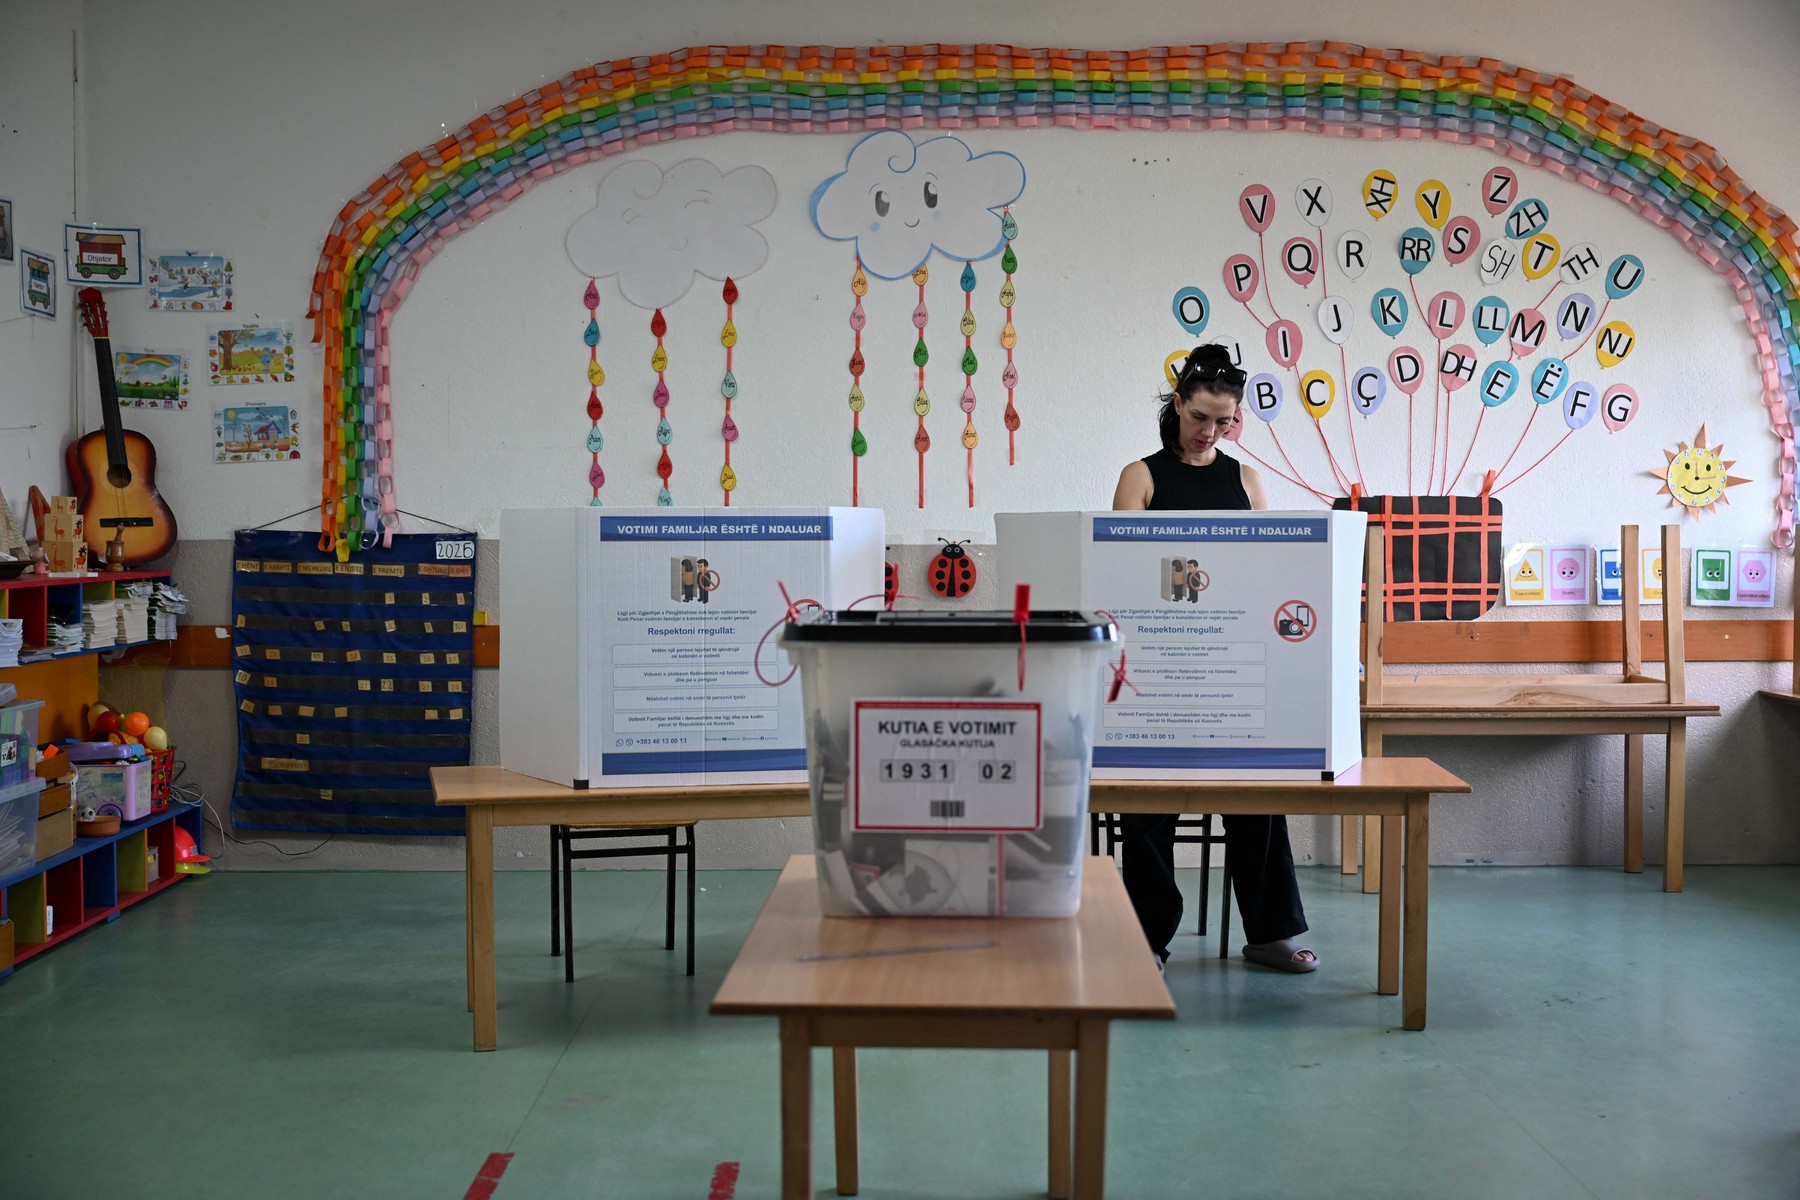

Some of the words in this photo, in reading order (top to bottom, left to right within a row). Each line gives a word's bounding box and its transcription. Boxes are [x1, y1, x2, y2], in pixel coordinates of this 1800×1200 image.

[1303, 186, 1325, 216] X
[1366, 176, 1395, 213] XH
[1490, 175, 1510, 203] Z
[1246, 195, 1267, 223] V
[1422, 191, 1440, 219] Y
[1509, 202, 1547, 237] ZH
[1346, 241, 1364, 267] R
[1401, 238, 1431, 261] RR
[1448, 228, 1468, 254] S
[1536, 241, 1554, 269] T
[1288, 244, 1315, 274] Q
[1481, 246, 1515, 279] SH
[1562, 248, 1599, 280] TH
[1234, 264, 1251, 292] P
[1614, 261, 1641, 289] U
[1180, 297, 1203, 324] O
[1332, 305, 1342, 332] J
[1380, 296, 1400, 325] K
[1439, 300, 1453, 328] L
[1478, 306, 1504, 331] LL
[1562, 301, 1589, 332] N
[1511, 313, 1545, 346] M
[1599, 328, 1632, 358] NJ
[1282, 331, 1288, 357] I
[1396, 355, 1419, 382] D
[1441, 350, 1477, 381] DH
[1306, 380, 1325, 406] C
[1358, 373, 1377, 407] Ç
[1486, 370, 1510, 399] E
[1536, 364, 1562, 398] Ë
[1257, 382, 1276, 409] B
[1570, 391, 1590, 416] F
[1608, 394, 1632, 422] G
[617, 525, 658, 534] VOTIMI
[662, 525, 718, 534] FAMILJAR
[720, 523, 758, 534] ËSHTË
[761, 525, 766, 534] I
[768, 525, 822, 534] NDALUAR
[1110, 526, 1149, 535] VOTIMI
[1153, 526, 1208, 535] FAMILJAR
[1211, 524, 1248, 535] ËSHTË
[1252, 527, 1255, 535] I
[1258, 527, 1312, 536] NDALUAR
[648, 628, 695, 636] Respektoni
[698, 627, 735, 636] rregullat:
[1187, 626, 1224, 635] rregullat:
[383, 680, 392, 689] 22
[878, 721, 928, 734] KUTIA
[934, 721, 944, 734] E
[950, 721, 1017, 734] VOTIMIT
[900, 738, 957, 748] GLASAČKA
[959, 739, 995, 748] KUTIJA
